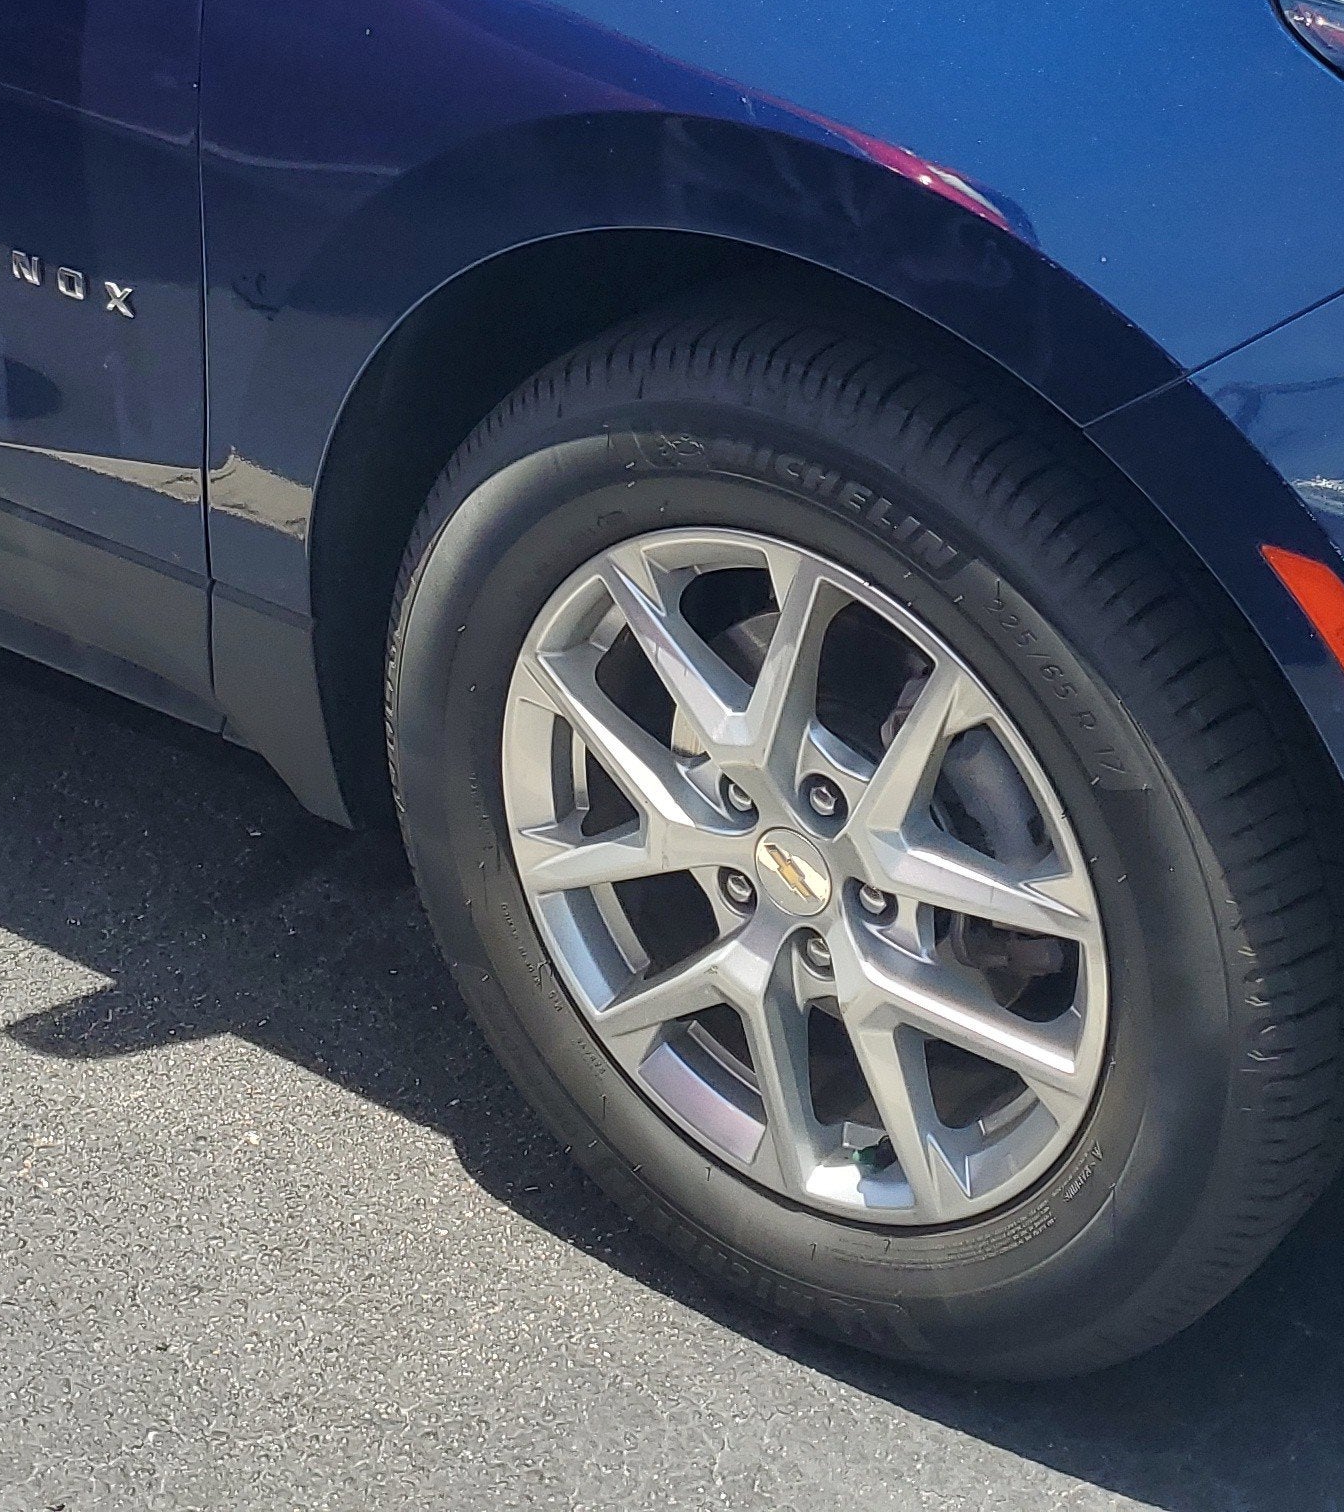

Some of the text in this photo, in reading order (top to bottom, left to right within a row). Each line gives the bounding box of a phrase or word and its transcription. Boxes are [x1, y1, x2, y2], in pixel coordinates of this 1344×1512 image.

[711, 438, 959, 569] MICHELIN
[985, 598, 1127, 774] 225/65 R 17
